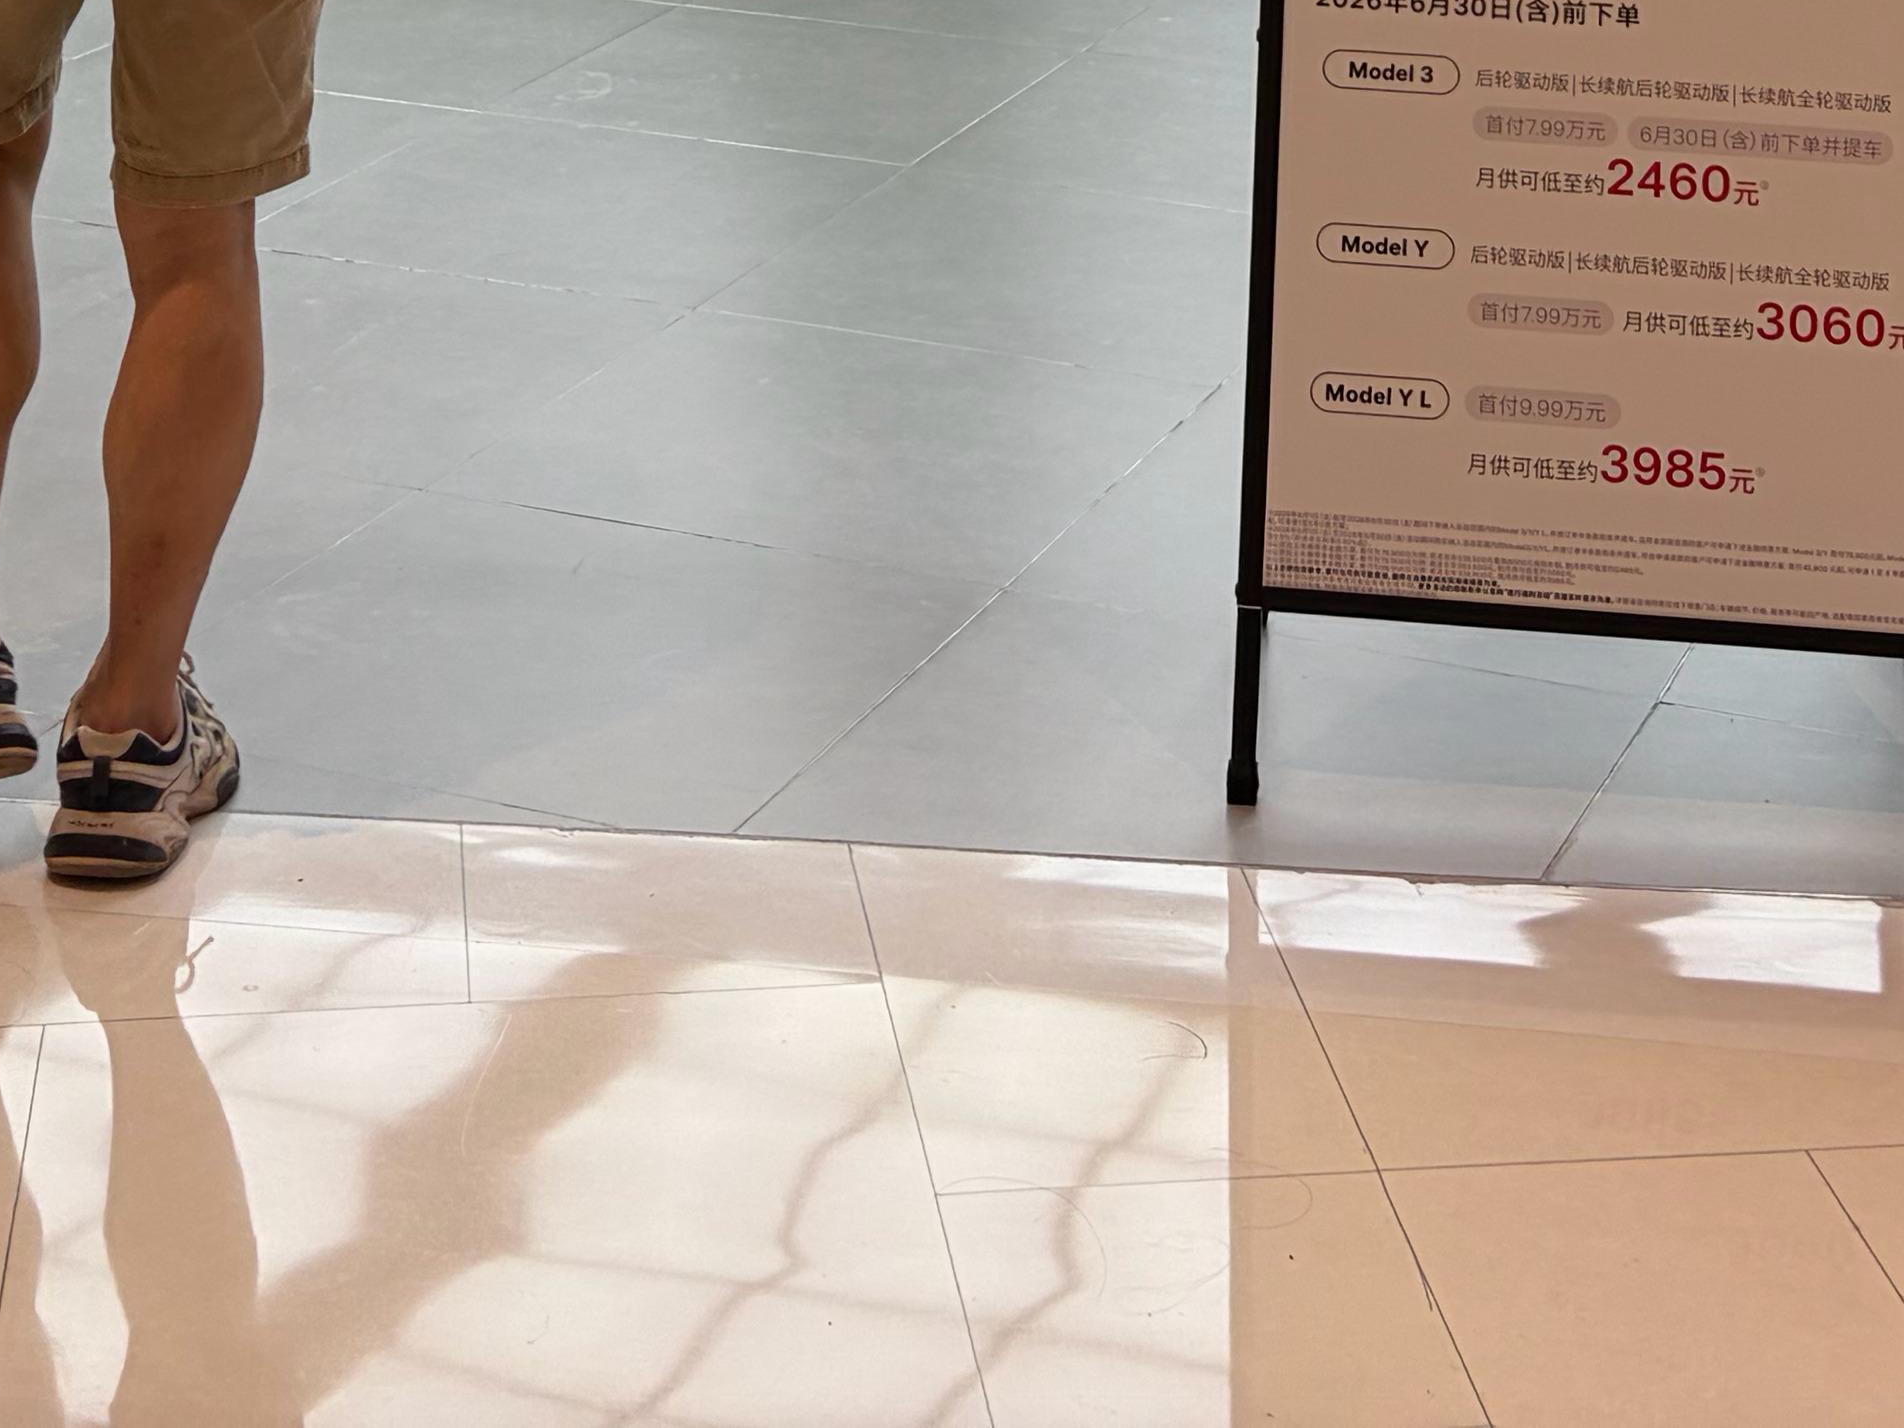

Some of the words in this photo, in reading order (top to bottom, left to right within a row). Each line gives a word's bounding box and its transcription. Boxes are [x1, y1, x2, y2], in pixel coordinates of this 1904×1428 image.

[1349, 61, 1413, 82] Model
[1421, 66, 1433, 83] 3
[1486, 115, 1605, 141] 首付7.99万元
[1341, 235, 1407, 256] Model
[1415, 240, 1429, 257] Y
[1480, 301, 1601, 329] 首付7.99万元
[1326, 384, 1391, 405] Model
[1400, 388, 1413, 406] Y
[1421, 391, 1431, 408] L
[1479, 394, 1606, 423] 首付9.99万元
